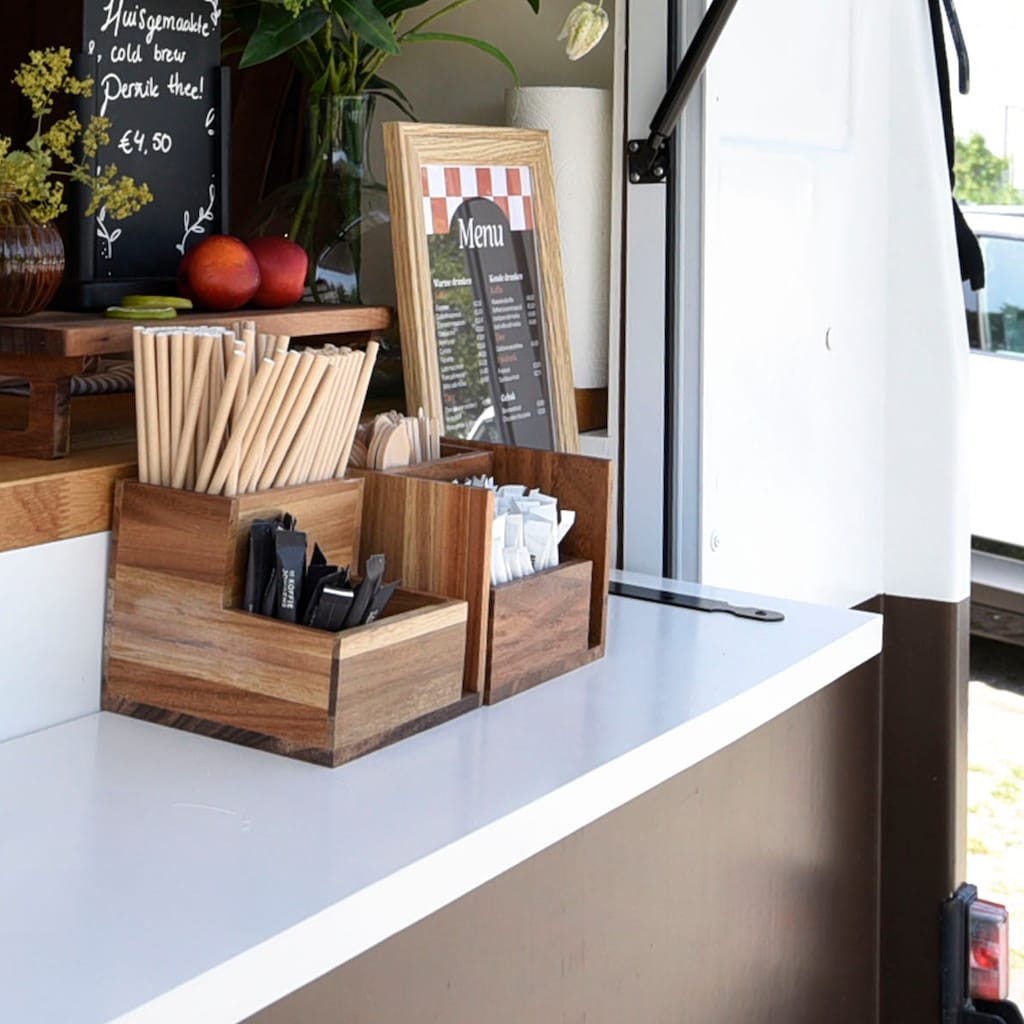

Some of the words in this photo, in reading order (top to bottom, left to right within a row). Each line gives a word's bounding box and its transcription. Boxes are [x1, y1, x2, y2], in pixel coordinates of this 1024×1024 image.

[110, 43, 143, 63] cold
[153, 43, 187, 63] brew
[167, 72, 204, 100] thee!
[117, 129, 172, 155] €4,50
[458, 218, 504, 249] Menu
[287, 578, 296, 609] KOFFIE
